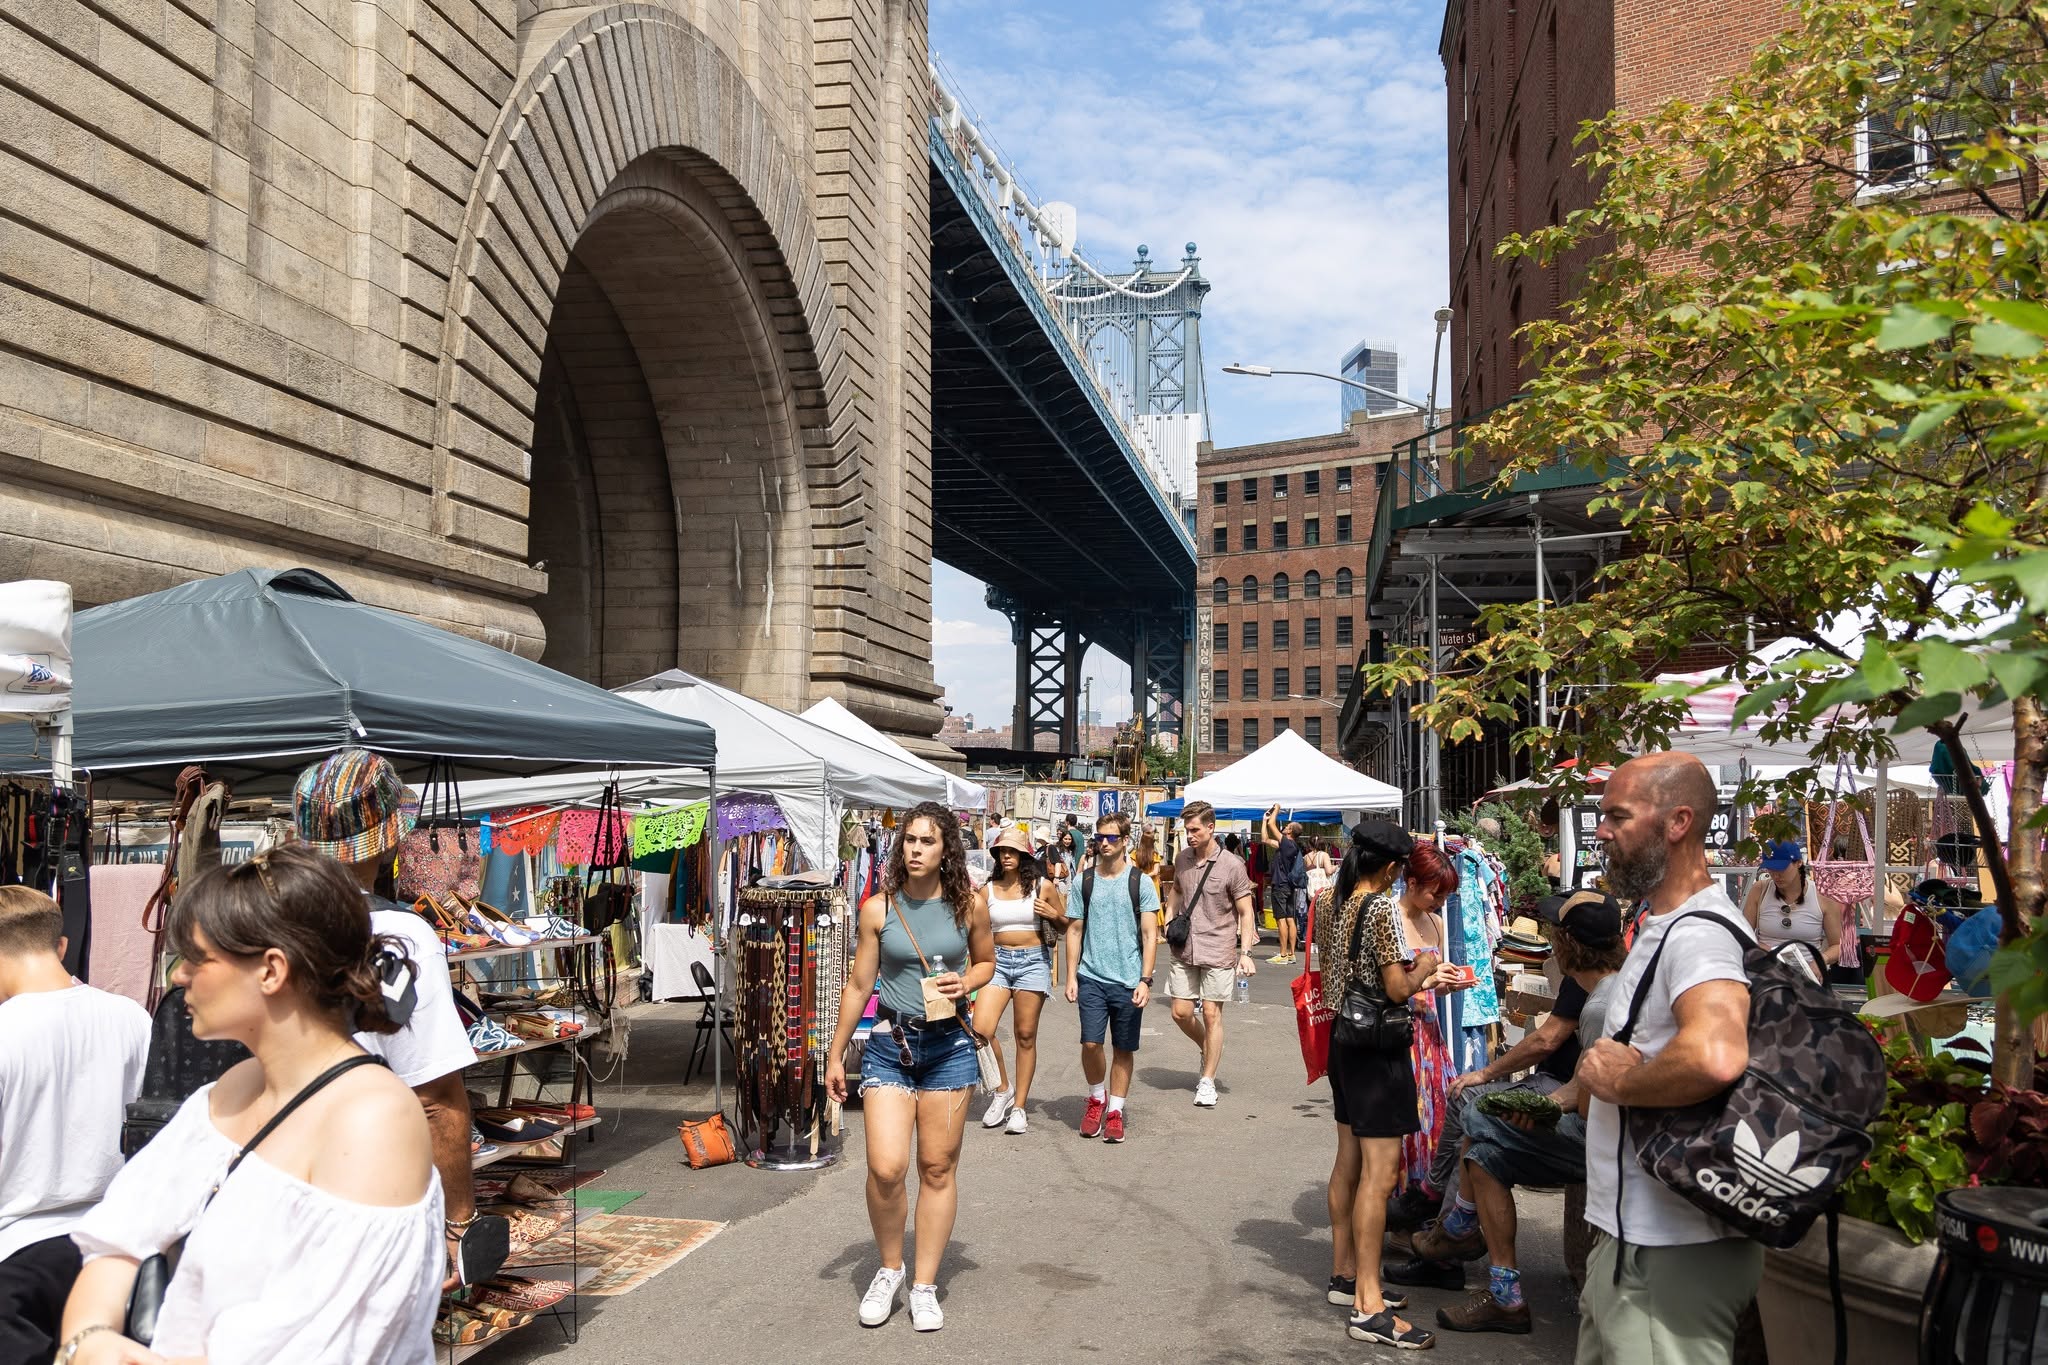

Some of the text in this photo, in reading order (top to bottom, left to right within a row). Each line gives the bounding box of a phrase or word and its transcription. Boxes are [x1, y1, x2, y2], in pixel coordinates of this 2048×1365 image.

[1200, 614, 1210, 665] WARING
[1440, 632, 1476, 645] Water St
[1200, 672, 1209, 743] ENVELOPE
[1696, 1168, 1790, 1227] adidas
